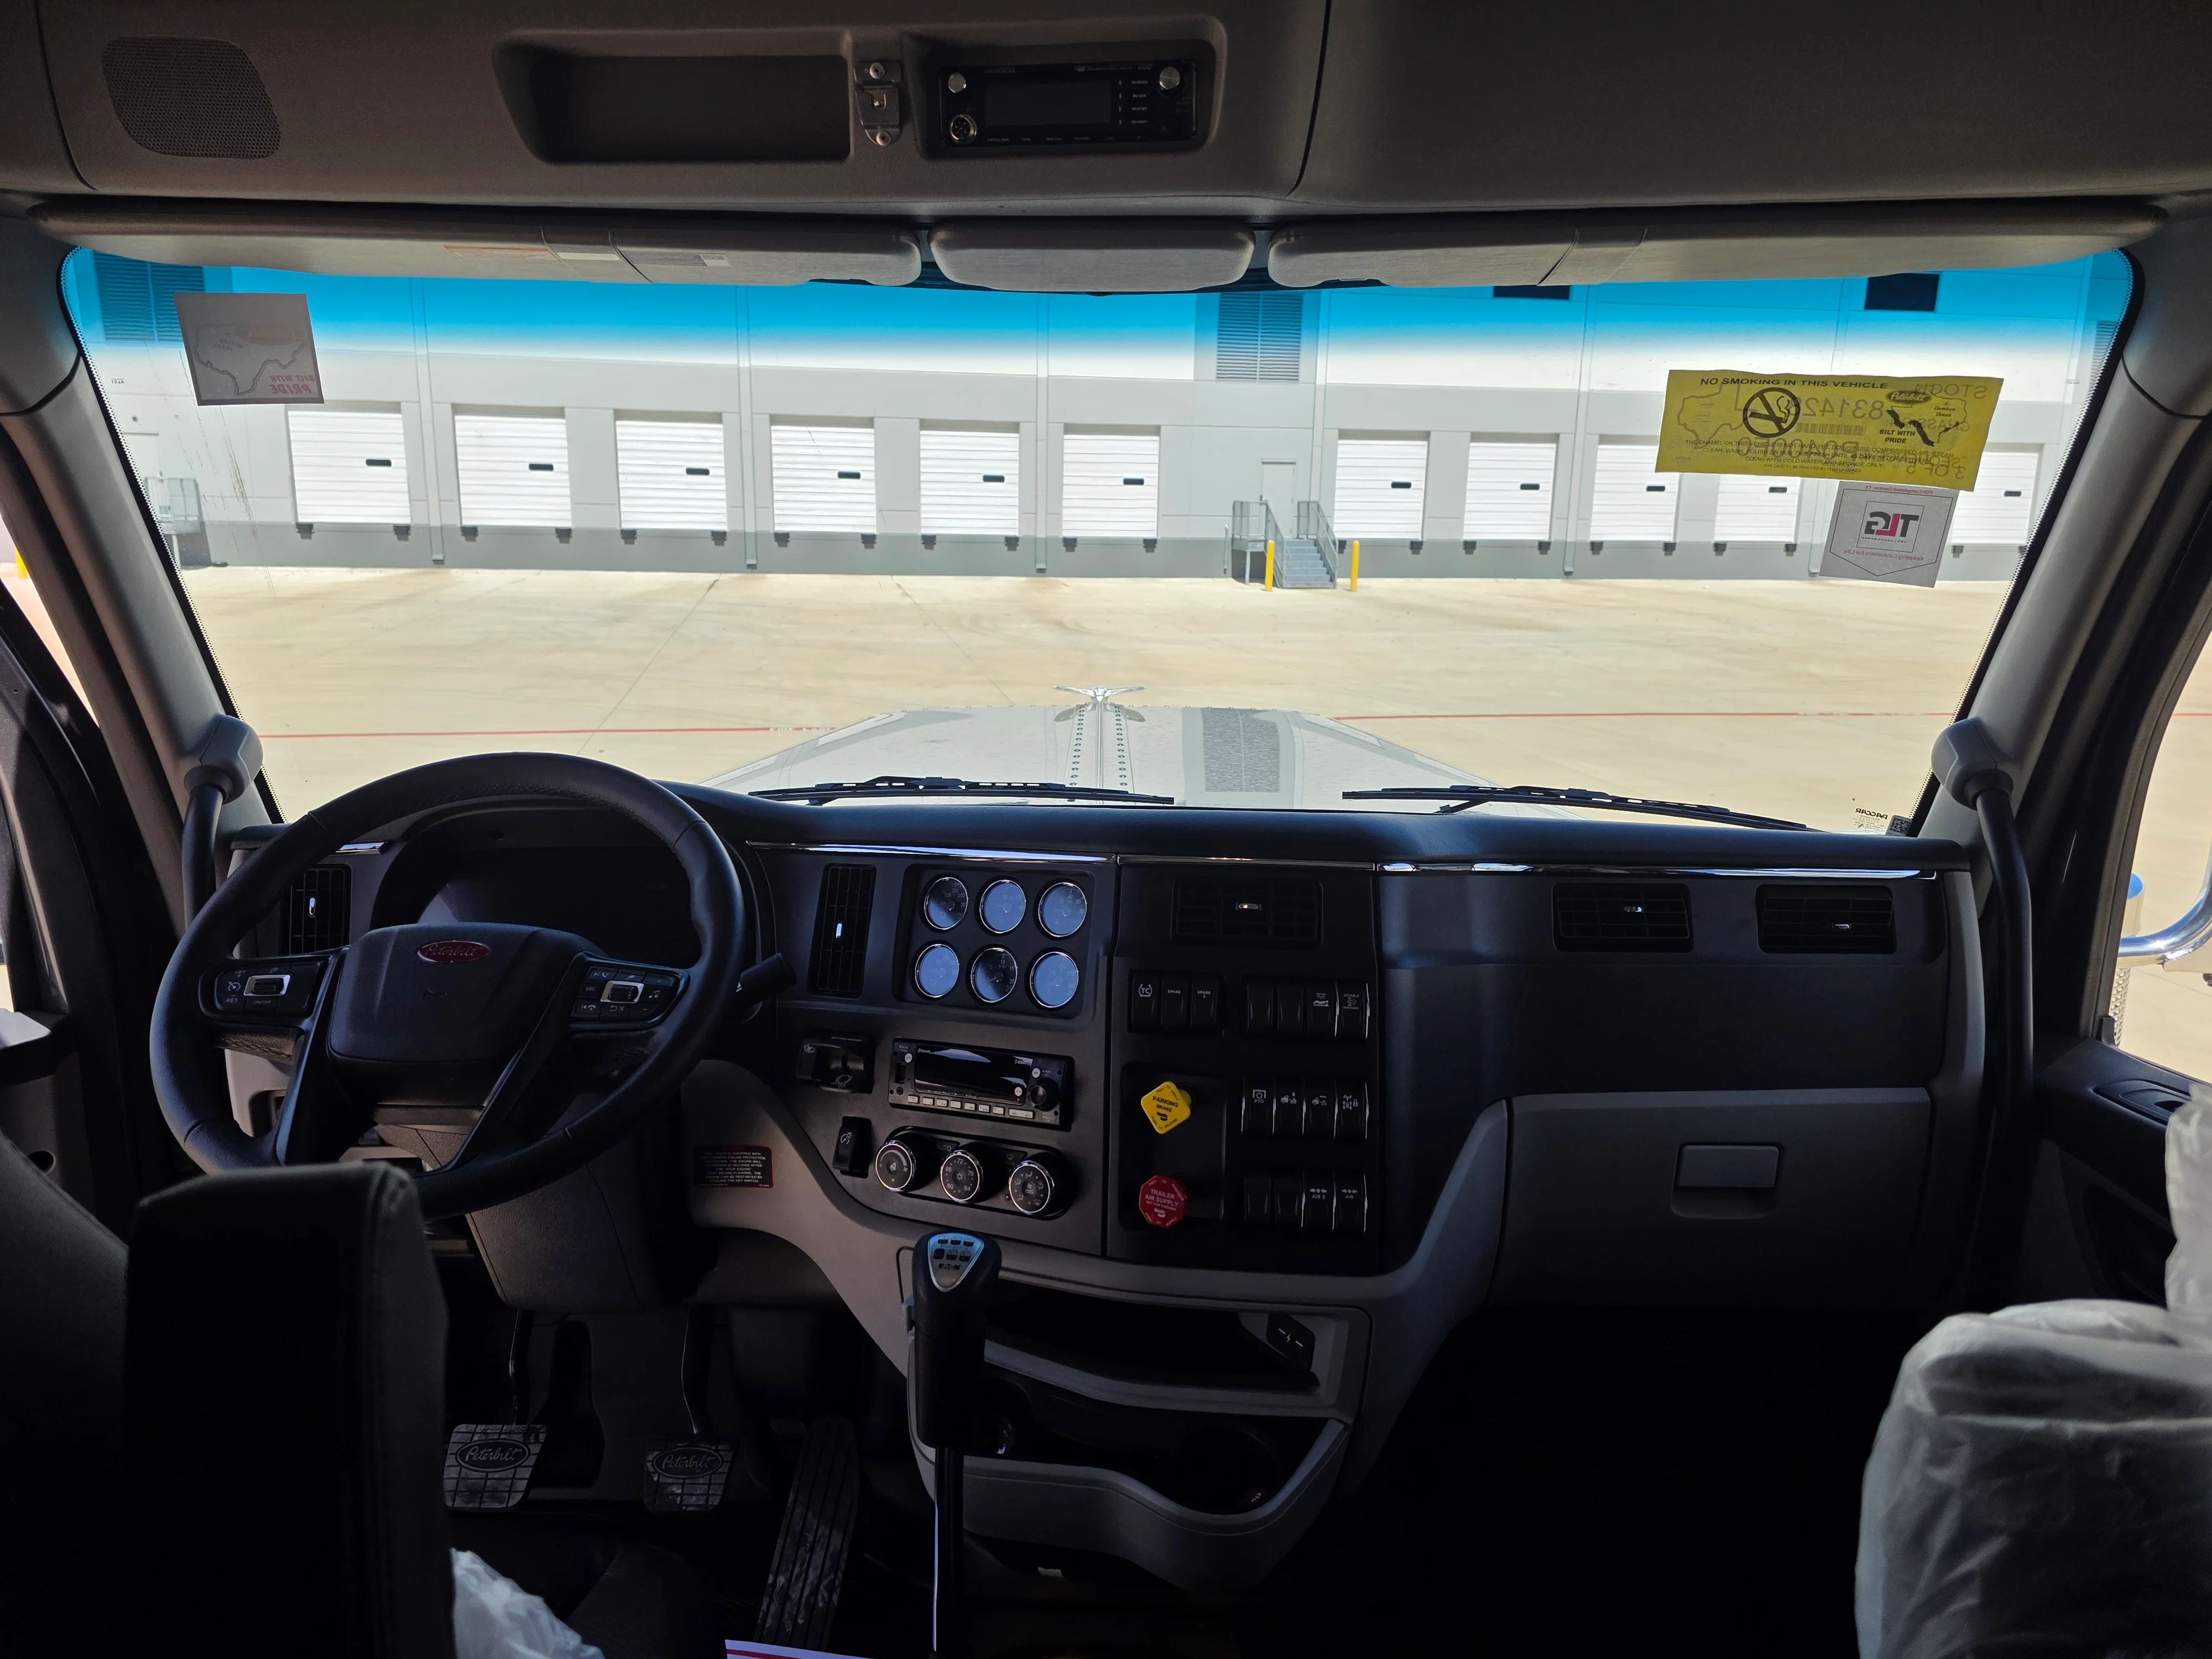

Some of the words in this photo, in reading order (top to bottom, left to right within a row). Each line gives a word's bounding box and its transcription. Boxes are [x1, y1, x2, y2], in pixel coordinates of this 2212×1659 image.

[1891, 392, 1928, 401] Peterbilt
[425, 944, 484, 956] Peterbilt
[1152, 1095, 1178, 1108] PARKING
[1156, 1104, 1172, 1113] BRAKE
[936, 1142, 952, 1152] AUTO
[1150, 1188, 1175, 1200] TRAILER
[1156, 1197, 1179, 1207] SUPPLY
[465, 1446, 523, 1463] Peterbilt
[662, 1454, 717, 1469] Peterbilt
